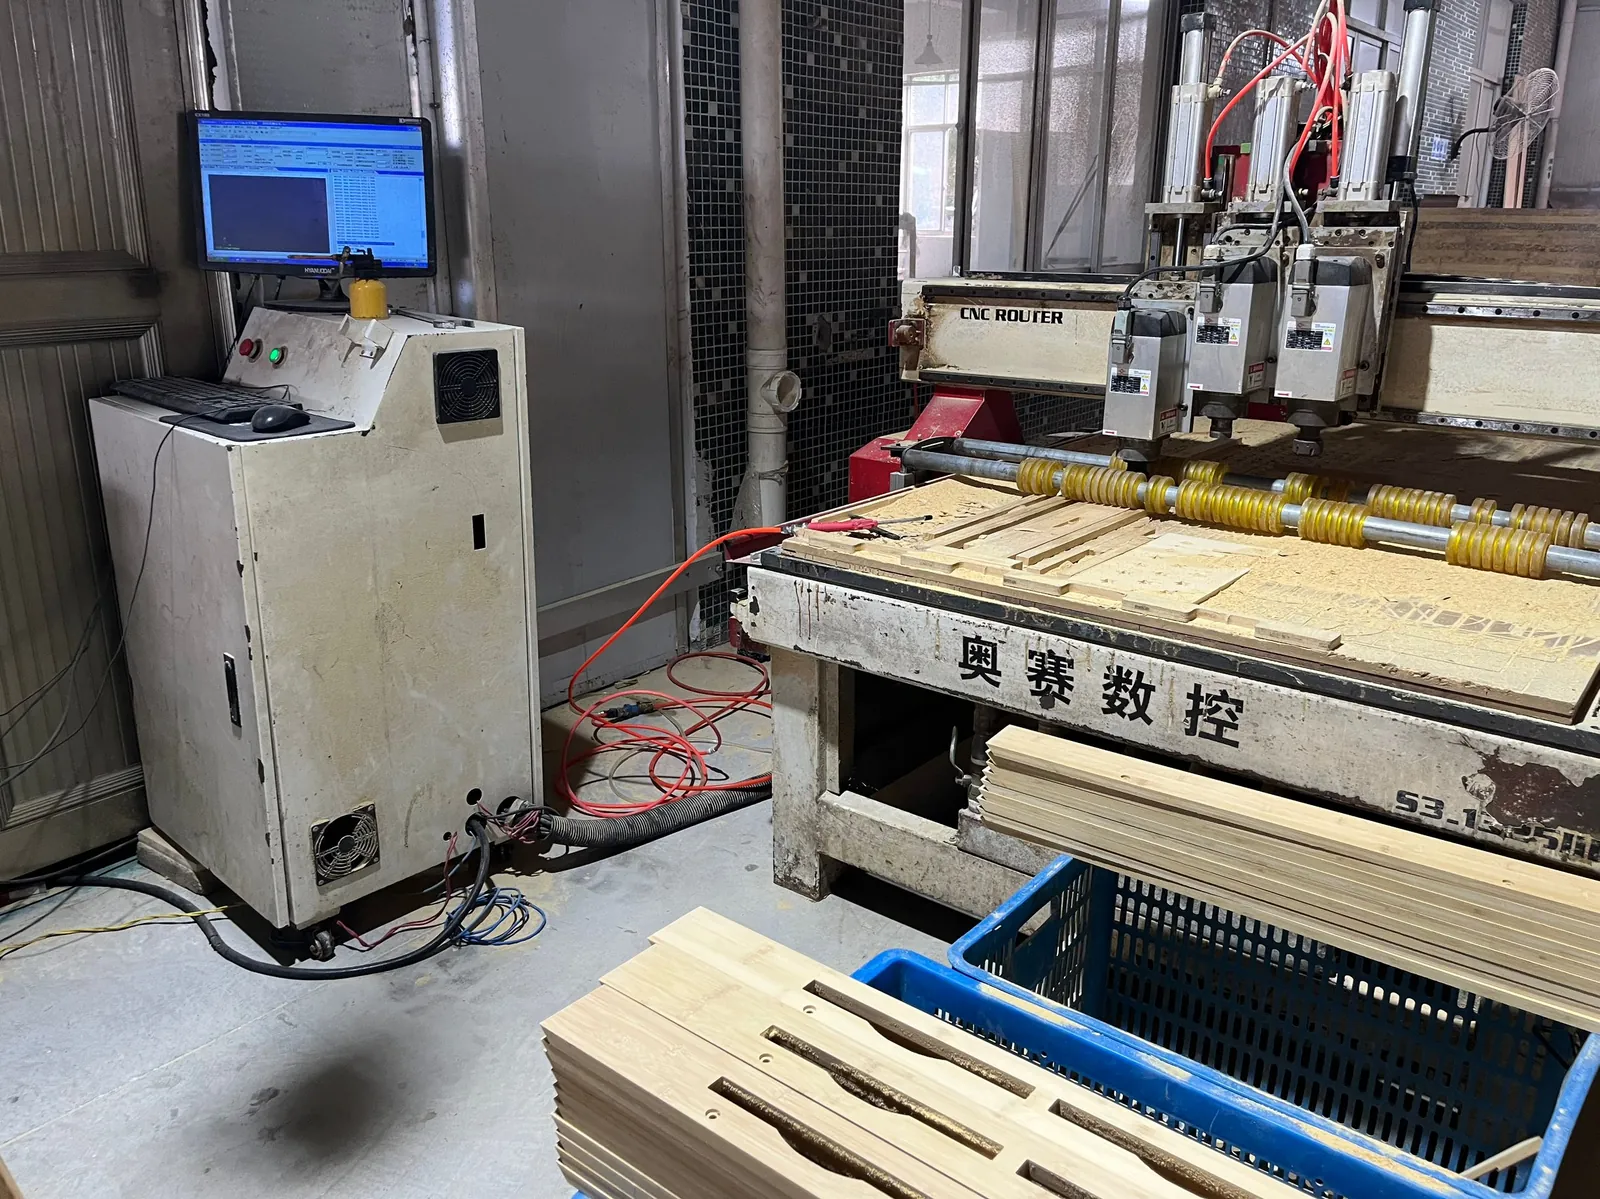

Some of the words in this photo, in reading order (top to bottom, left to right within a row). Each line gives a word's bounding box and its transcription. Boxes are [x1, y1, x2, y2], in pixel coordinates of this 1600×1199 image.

[960, 307, 990, 320] CNC
[995, 308, 1063, 324] ROUTER
[958, 635, 1244, 748] 奥赛数控
